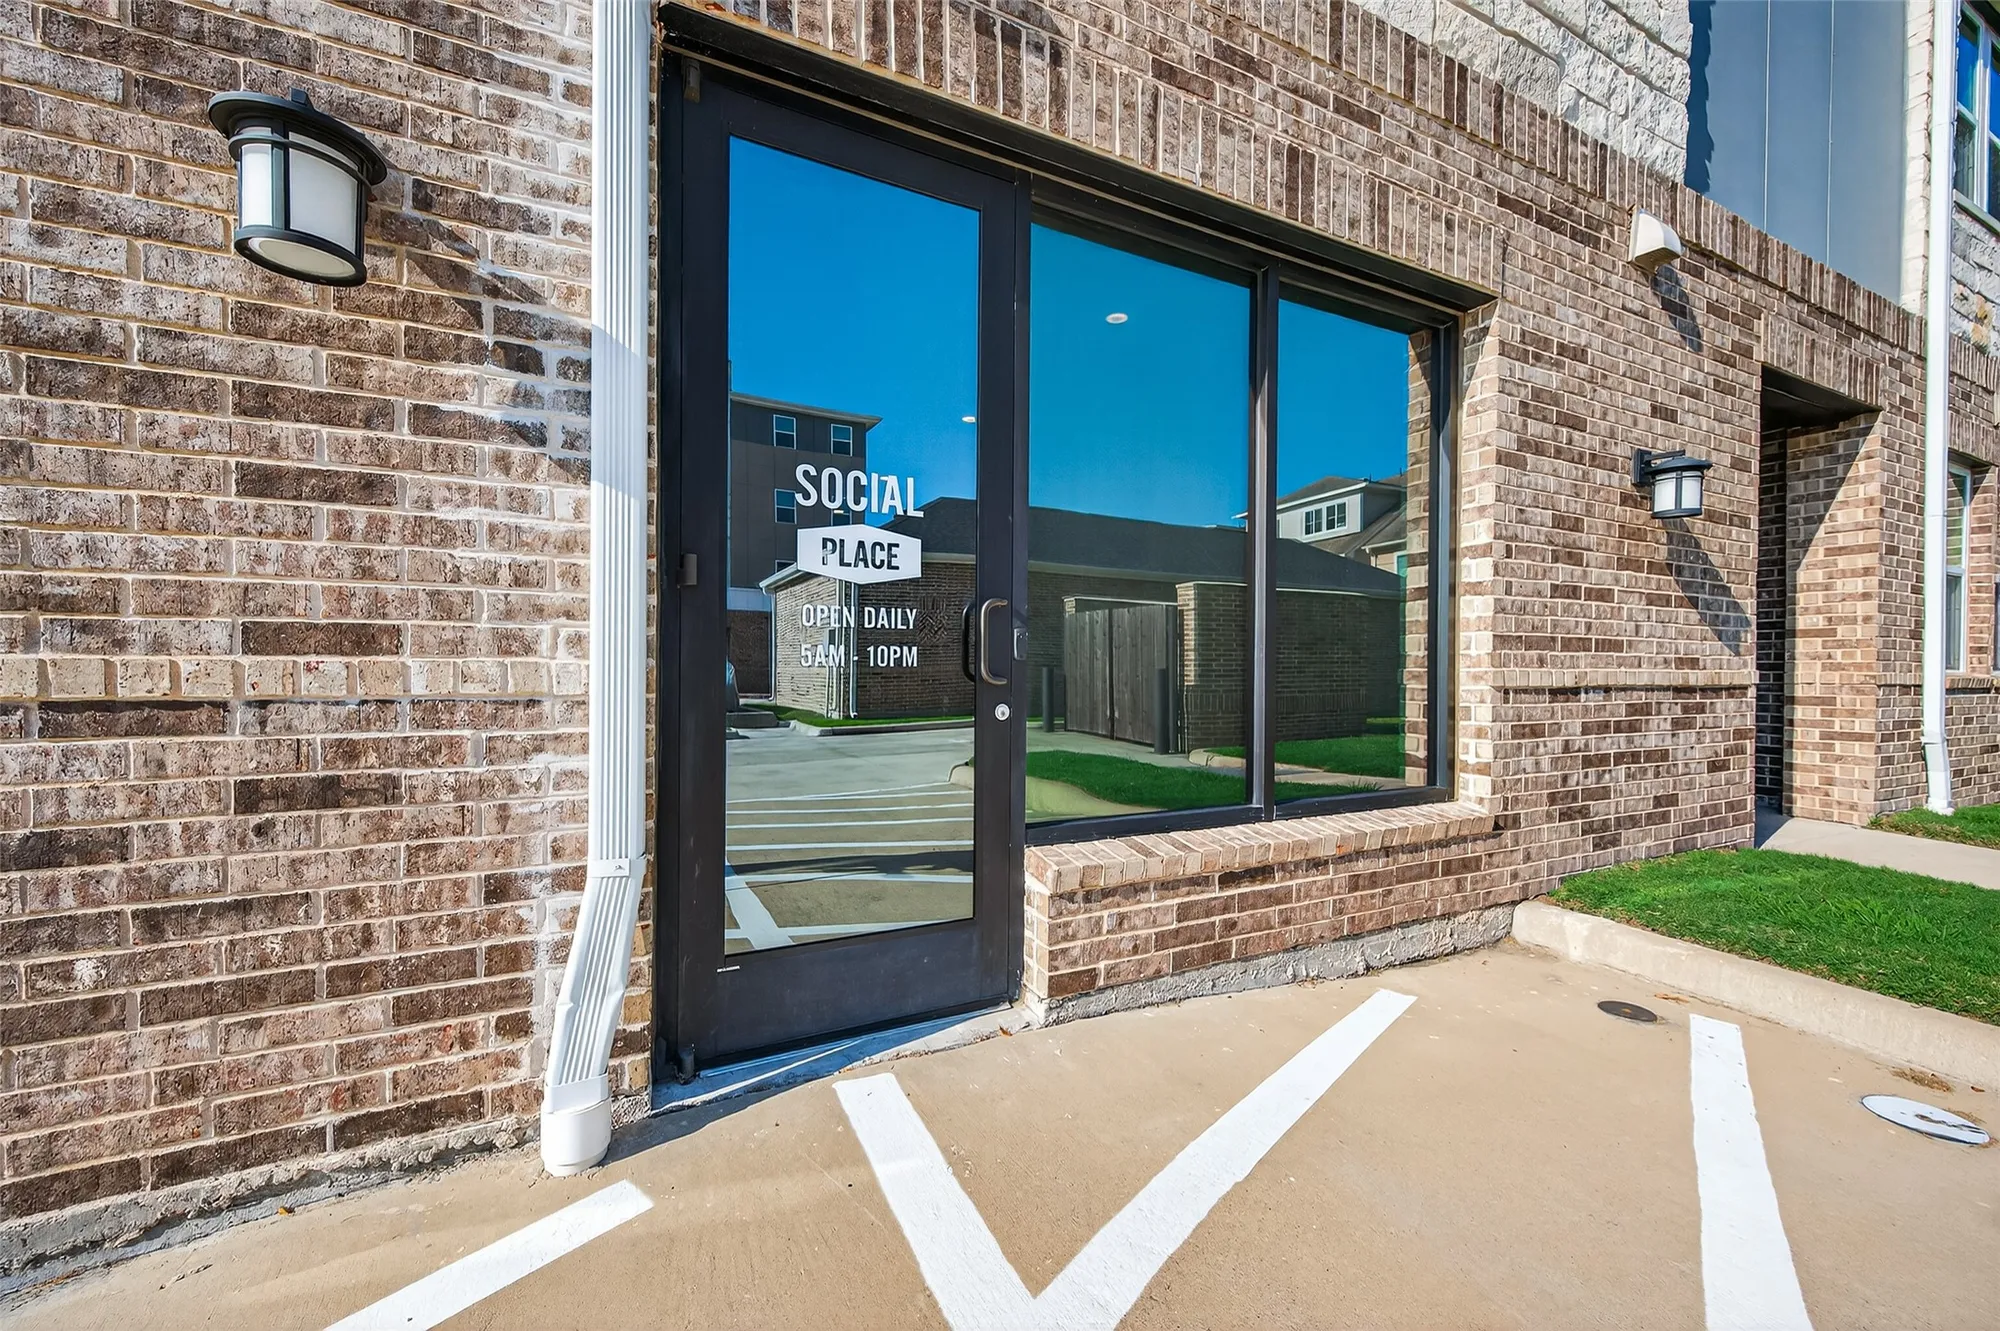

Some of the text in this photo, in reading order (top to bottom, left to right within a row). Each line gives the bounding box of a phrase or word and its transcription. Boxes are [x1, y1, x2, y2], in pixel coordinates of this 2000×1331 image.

[795, 464, 924, 518] SOCIAL
[821, 537, 900, 570] PLACE
[802, 604, 917, 629] OPEN DAILY
[800, 644, 845, 668] 5AM
[867, 645, 918, 668] 10PM
